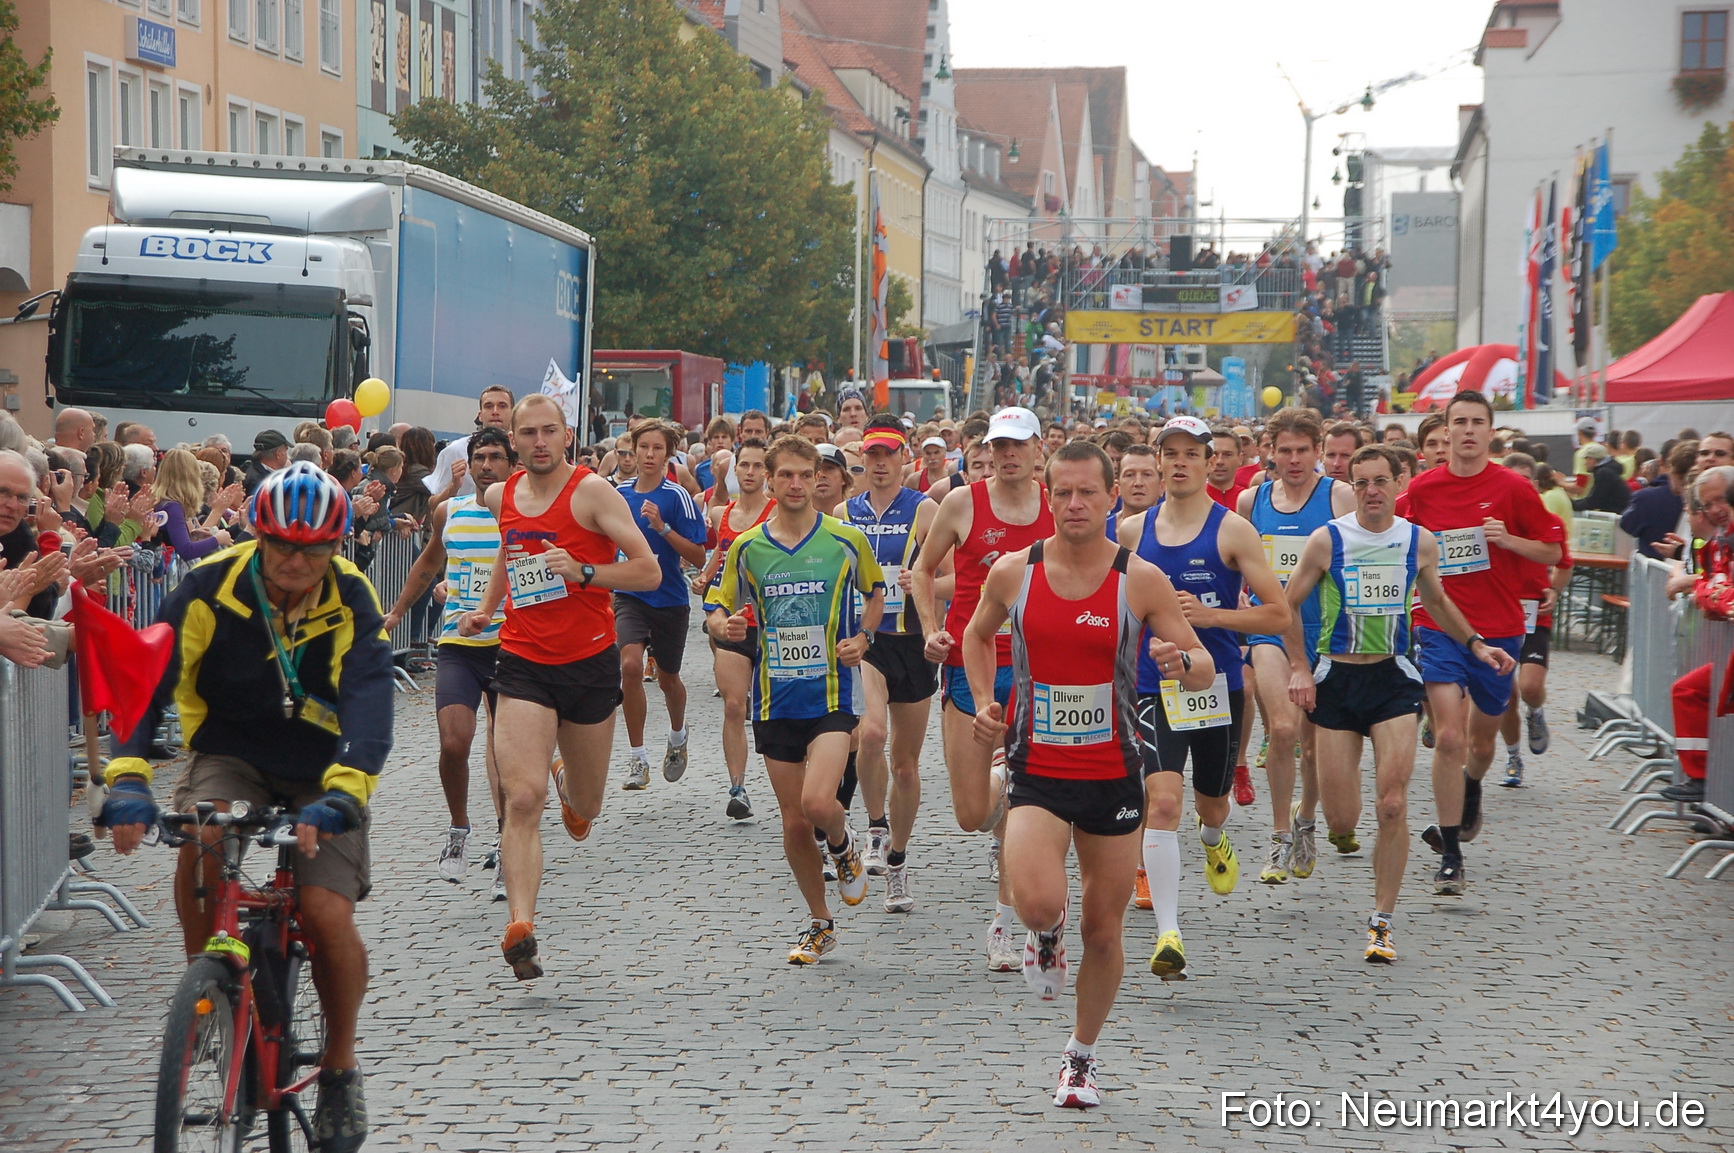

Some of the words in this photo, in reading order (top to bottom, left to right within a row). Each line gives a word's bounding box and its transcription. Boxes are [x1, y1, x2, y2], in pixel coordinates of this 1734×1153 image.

[140, 235, 273, 264] BOCK
[1139, 318, 1218, 337] START
[1445, 533, 1476, 543] Christian
[1448, 544, 1482, 559] 2226
[515, 557, 537, 568] Stefan
[1280, 553, 1298, 566] 99
[518, 567, 554, 587] 3318
[763, 572, 791, 580] TEAM
[1362, 571, 1381, 580] Hans
[764, 580, 827, 598] BOCK
[1364, 585, 1399, 598] 3186
[779, 631, 808, 641] Michael
[782, 645, 821, 661] 2002
[1053, 691, 1084, 703] Oliver
[1187, 694, 1218, 712] 903
[1036, 706, 1041, 715] A
[1055, 708, 1105, 726] 2000
